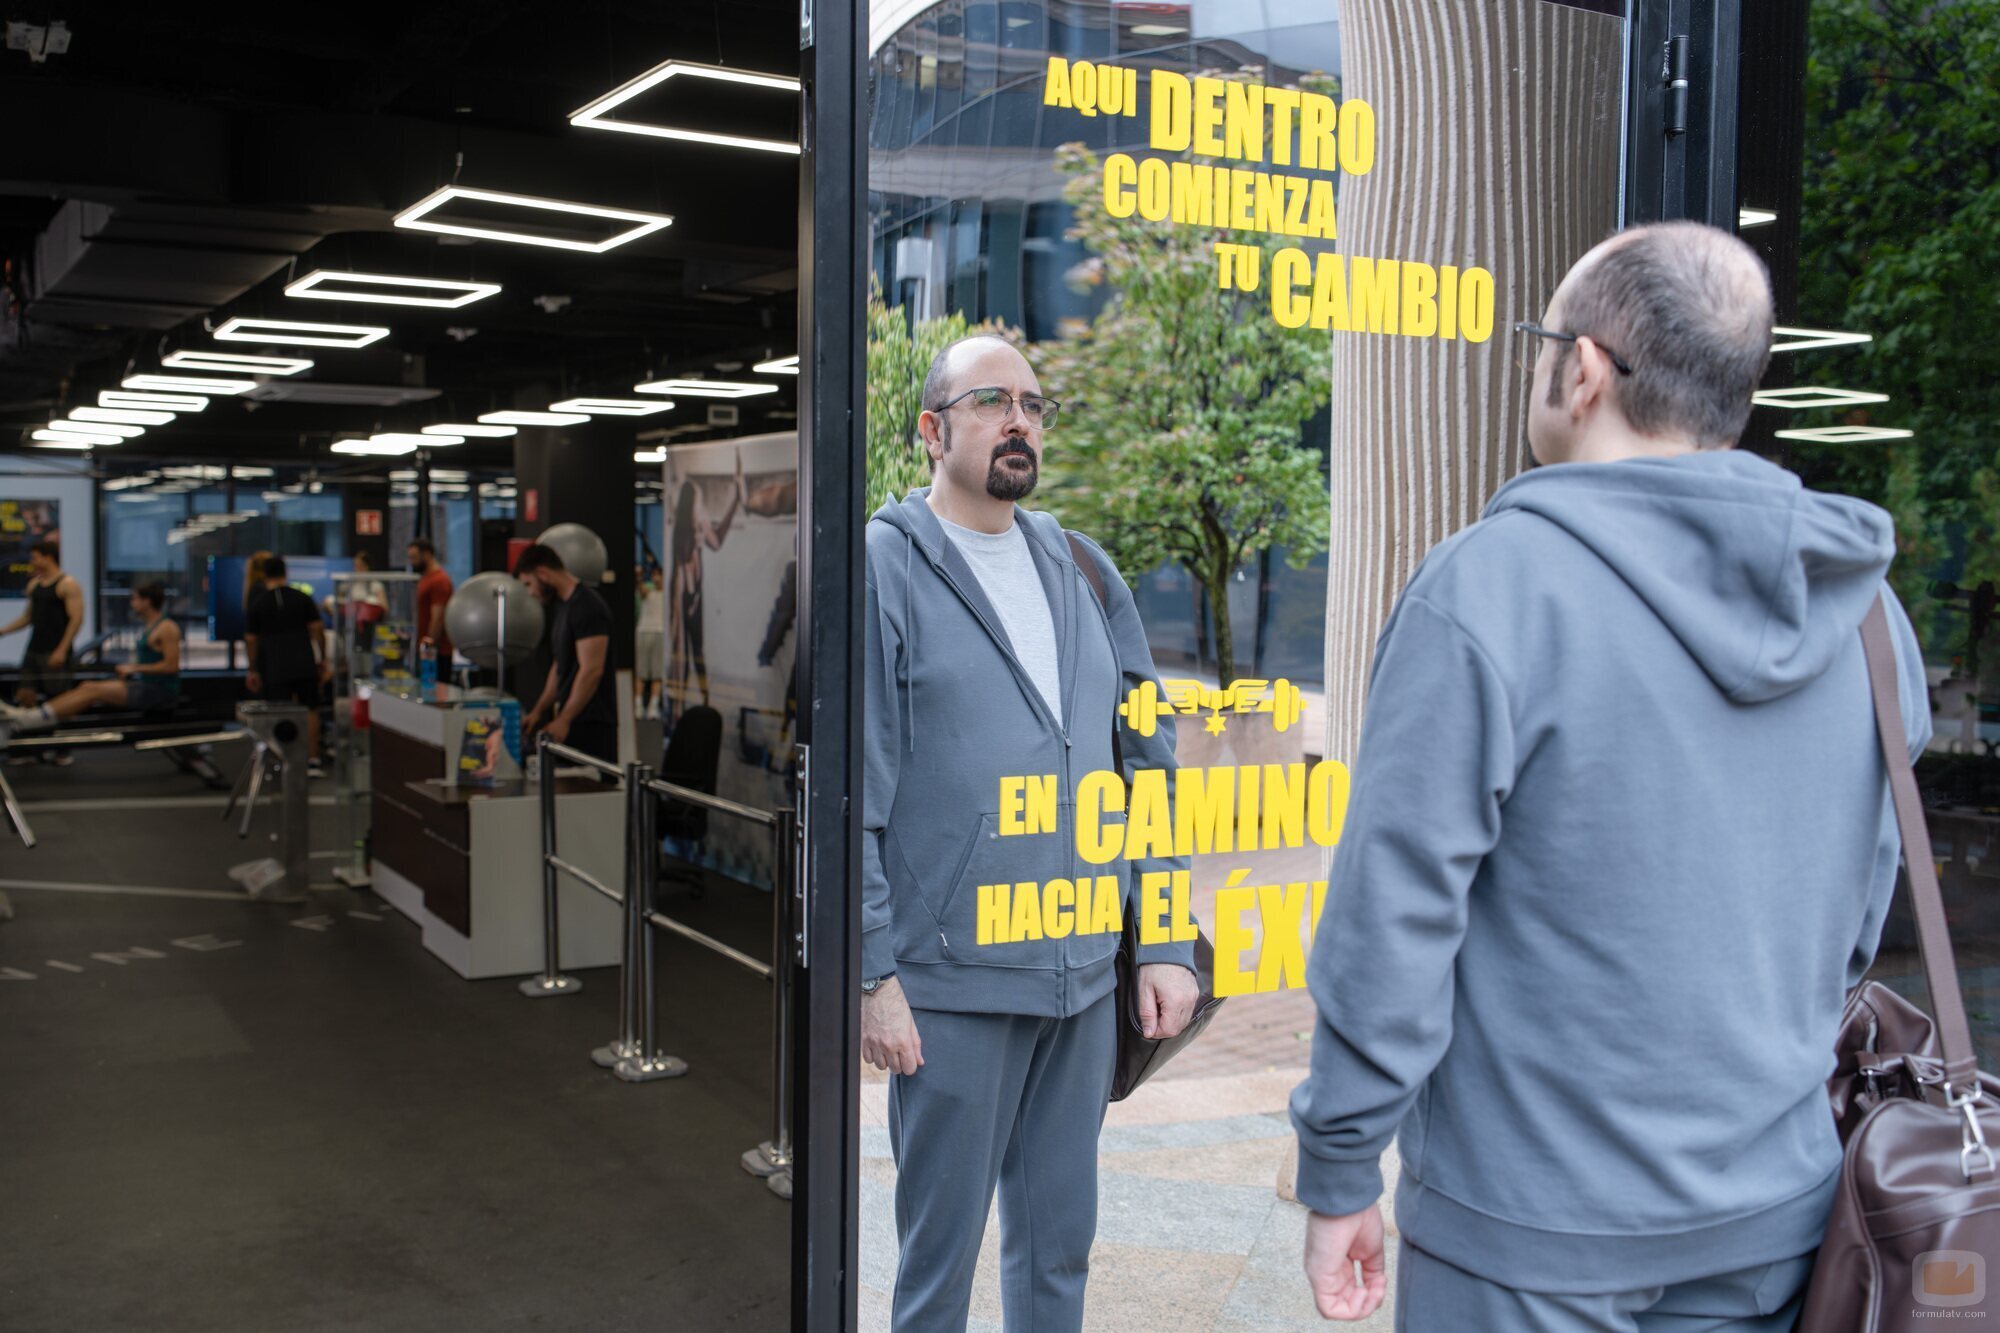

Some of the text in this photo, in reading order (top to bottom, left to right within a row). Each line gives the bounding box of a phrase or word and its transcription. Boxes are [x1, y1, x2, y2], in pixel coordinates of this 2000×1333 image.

[1044, 56, 1375, 176] AQUI DENTRO
[1103, 153, 1336, 239] COMIENZA
[1214, 243, 1494, 343] TU CAMBIO
[1000, 760, 1350, 864] EN CAMINO
[976, 868, 1329, 998] HACIA EL ÉX
